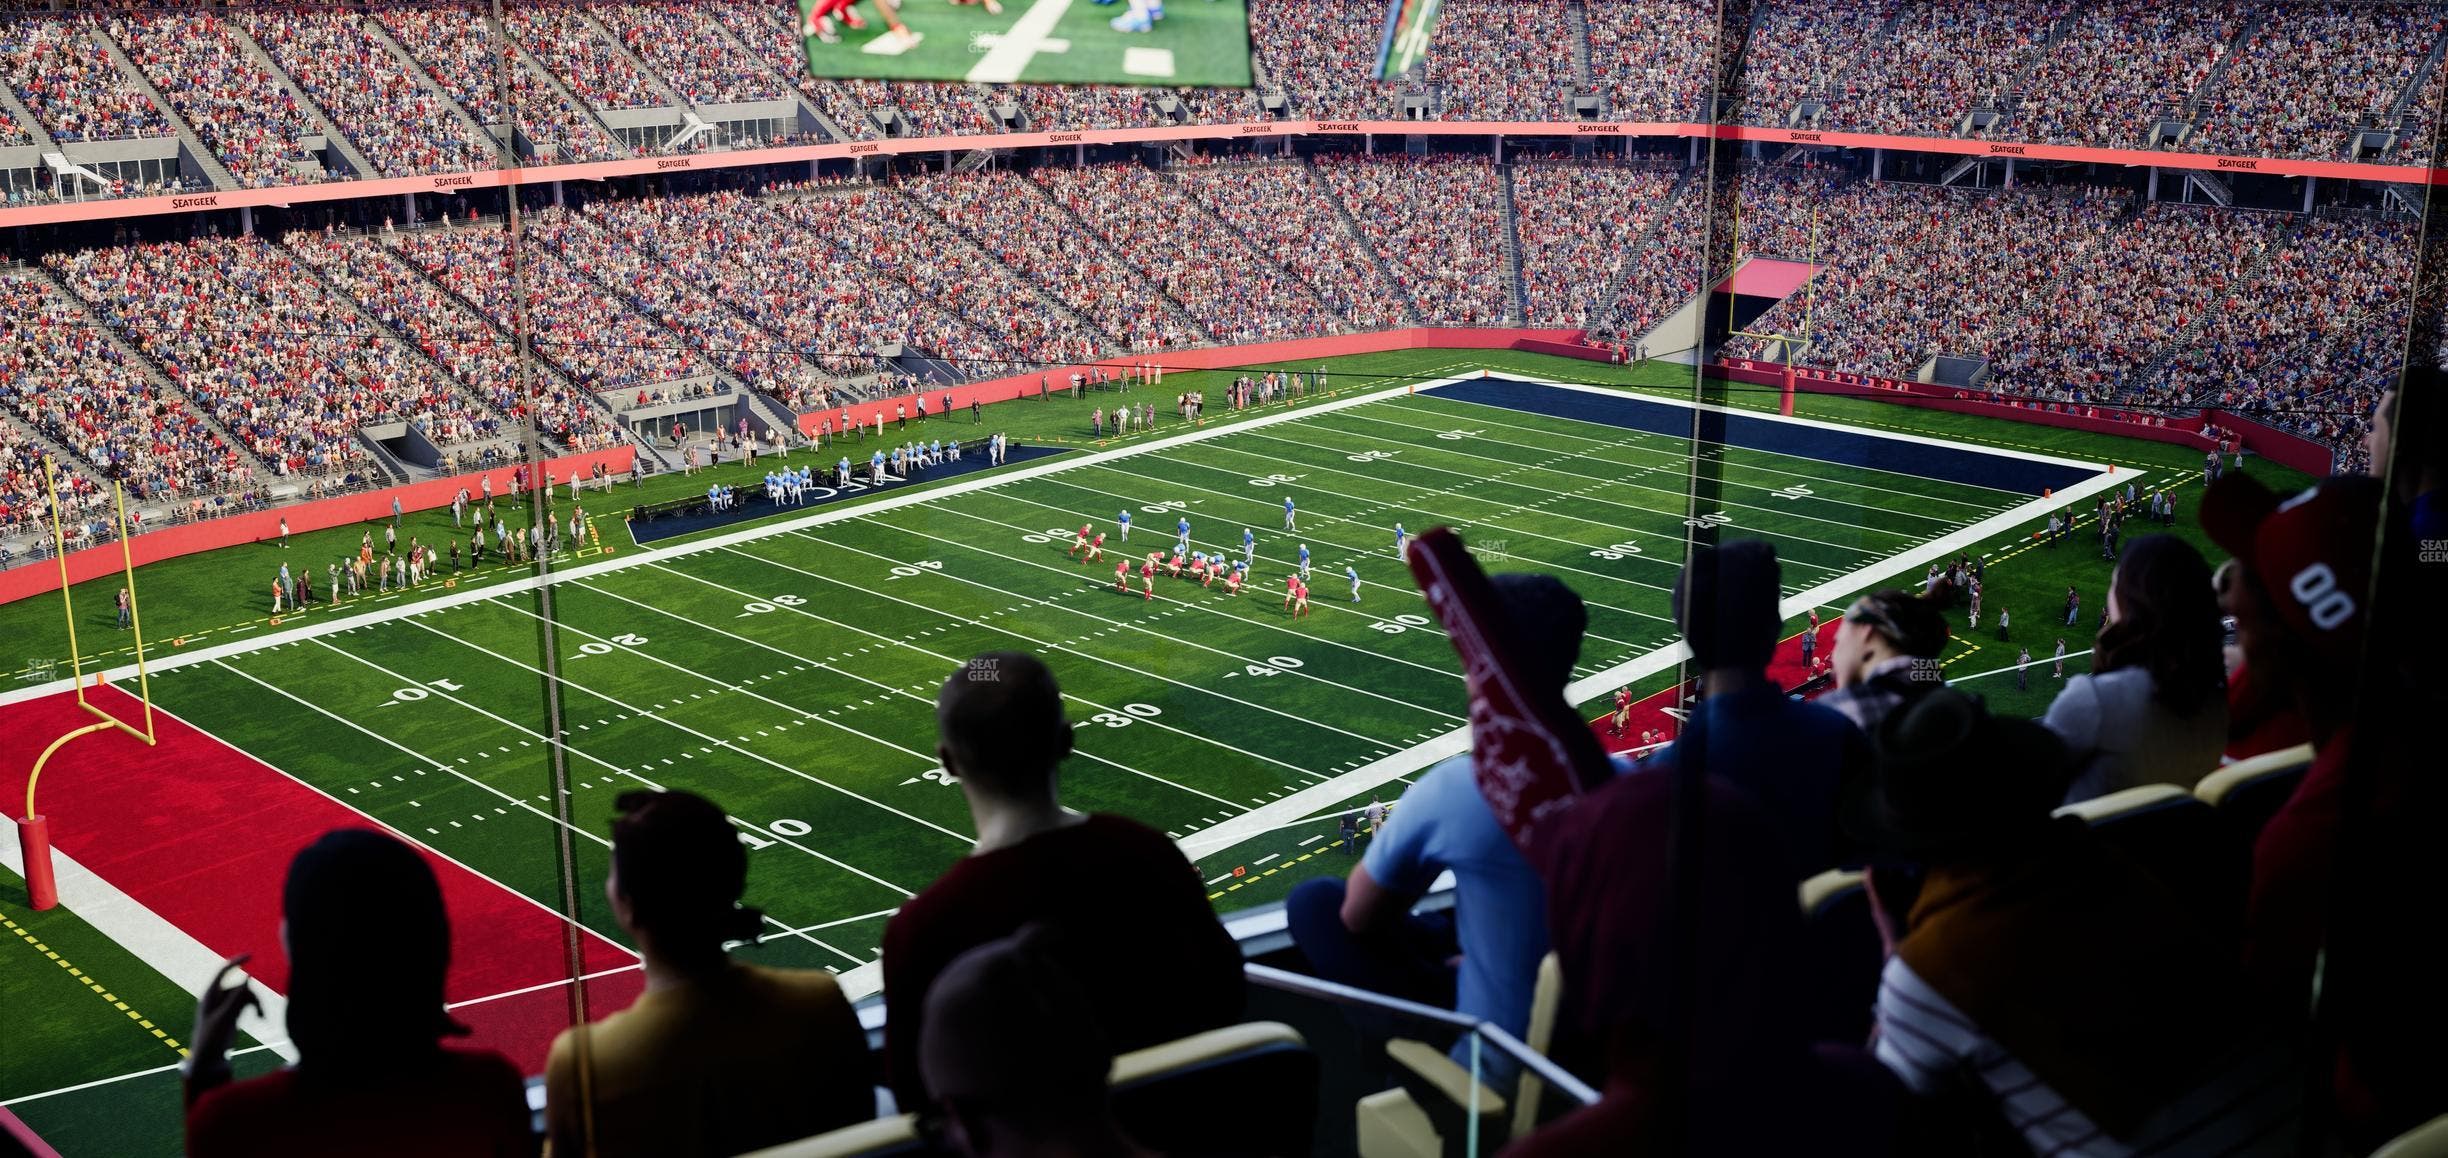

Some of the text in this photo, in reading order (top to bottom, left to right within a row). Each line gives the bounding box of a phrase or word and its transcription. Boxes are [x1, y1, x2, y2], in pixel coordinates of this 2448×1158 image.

[1243, 125, 1272, 133] SEATGEEK
[1318, 123, 1359, 131] SEATGEEK
[1050, 134, 1082, 143] SEATGEEK
[1790, 132, 1822, 142] SEATGEEK
[850, 144, 879, 154] SEATGEEK
[1990, 144, 2025, 154] SEATGEEK
[658, 159, 690, 169] SEATGEEK
[2217, 159, 2257, 169] SEATGEEK
[435, 176, 473, 187] SEATGEEK
[172, 196, 218, 208] SEATGEEK
[1436, 429, 1477, 440] 10
[1346, 450, 1393, 462] 20
[1248, 474, 1297, 487] 30
[1771, 486, 1815, 500] 10
[1140, 500, 1187, 514] 40
[1683, 513, 1733, 529] 20
[1022, 528, 1078, 543] 50
[1589, 543, 1643, 560] 30
[890, 560, 943, 576] 40
[2290, 561, 2356, 631] 00
[744, 594, 808, 613] 30
[1367, 614, 1431, 634] 50
[578, 633, 649, 655] 20
[1245, 656, 1305, 677] 40
[392, 678, 464, 701] 10
[1090, 703, 1162, 728] 30
[921, 766, 963, 787] 2
[737, 819, 812, 850] 10
